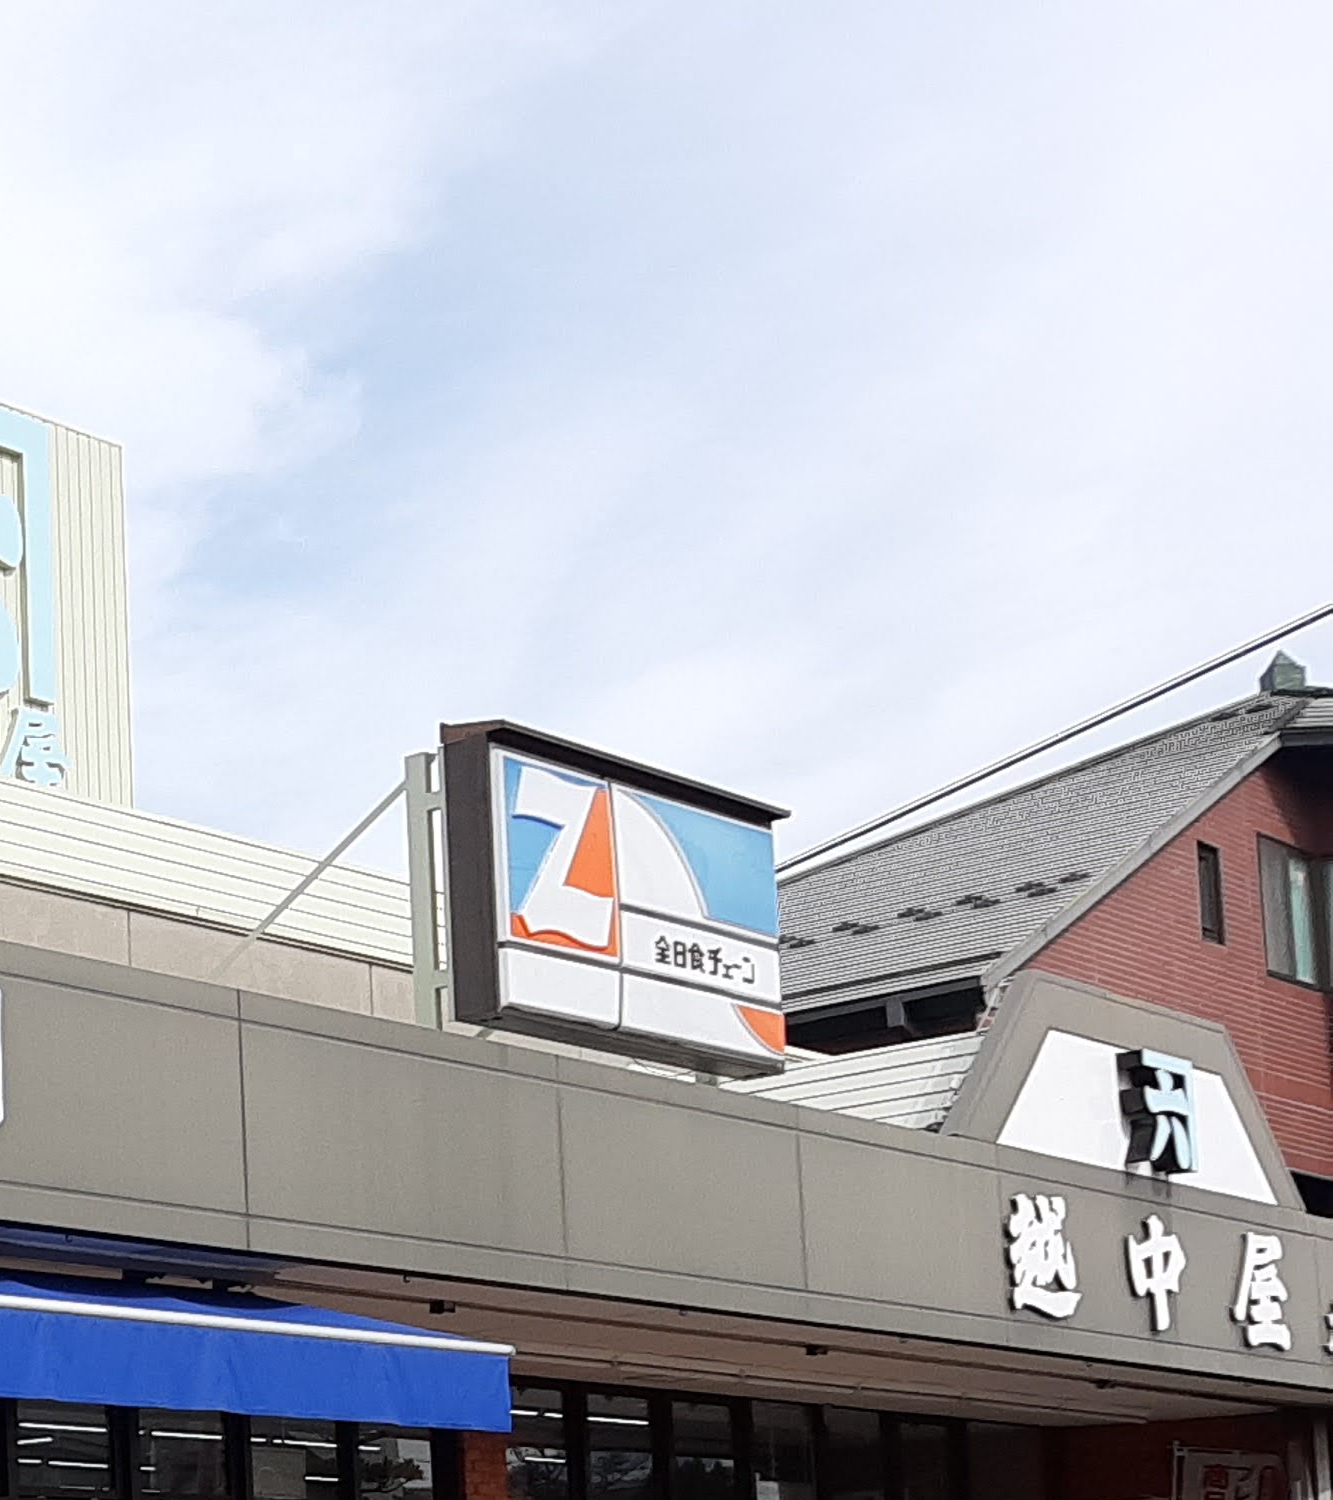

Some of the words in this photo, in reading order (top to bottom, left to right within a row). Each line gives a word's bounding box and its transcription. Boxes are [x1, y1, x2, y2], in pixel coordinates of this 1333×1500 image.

[653, 934, 757, 985] 全日食チェーン
